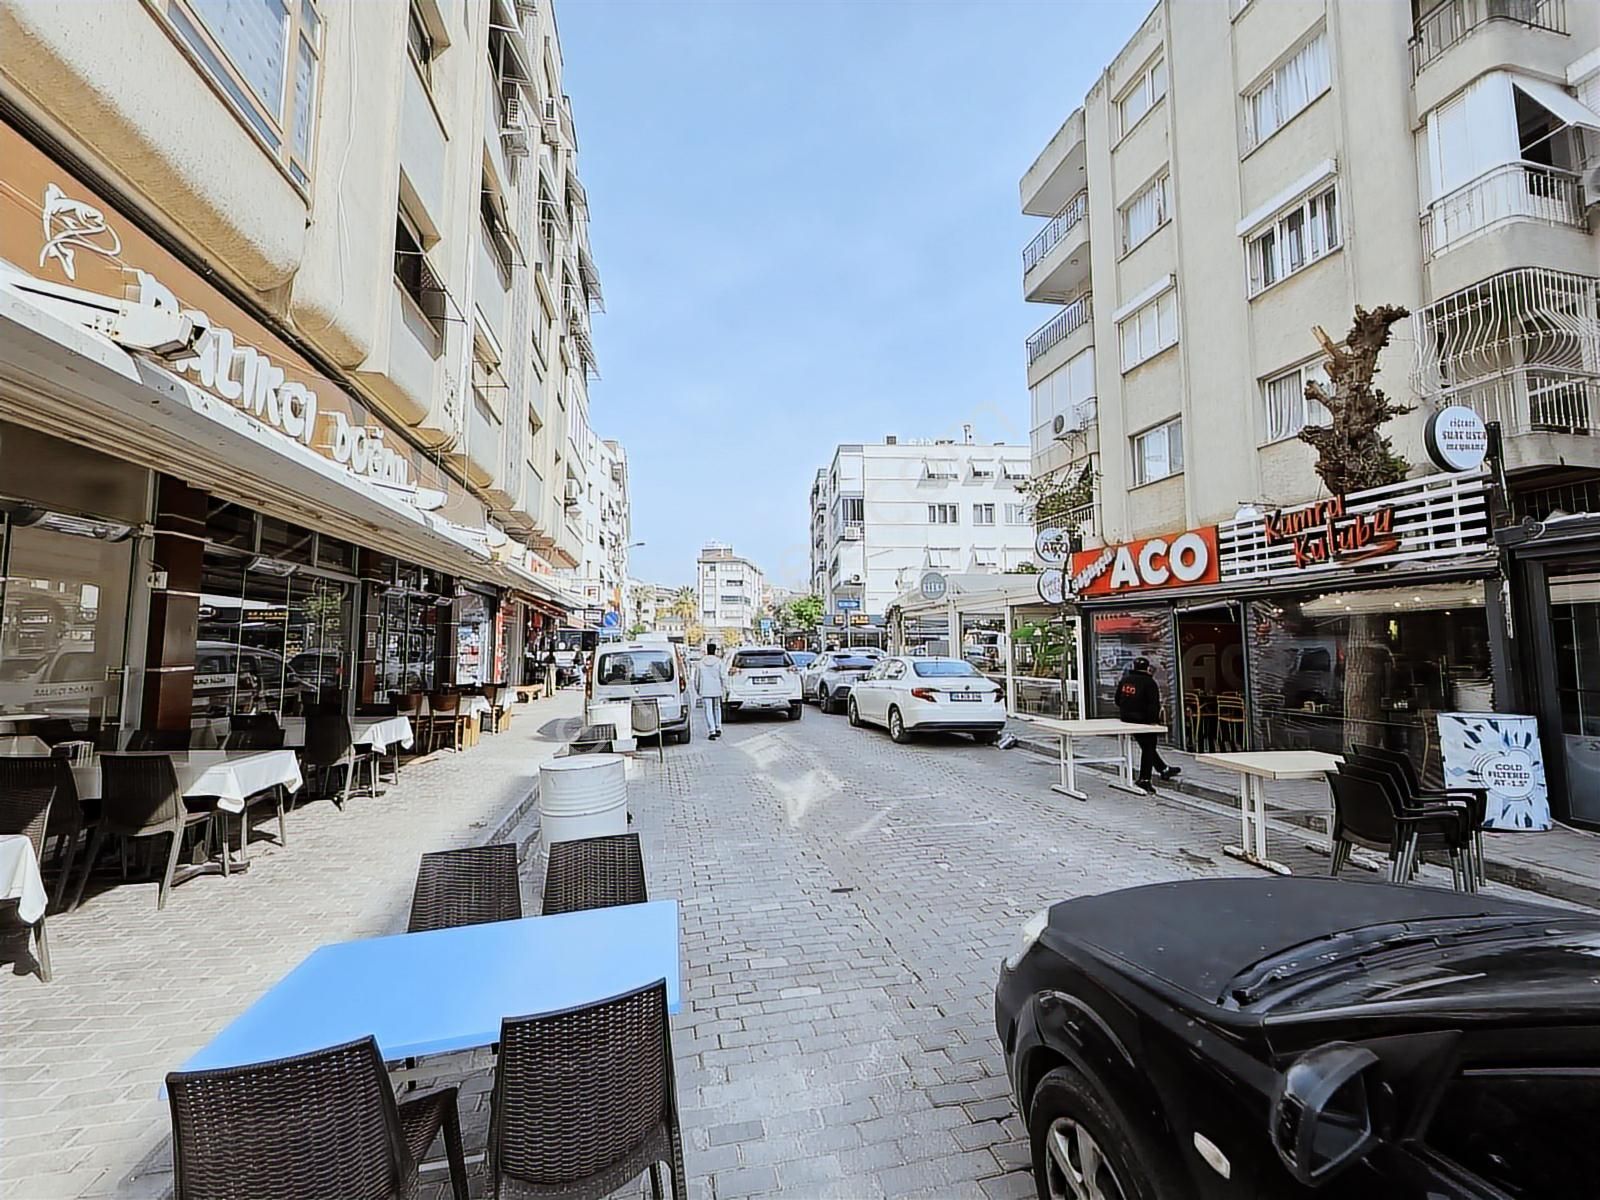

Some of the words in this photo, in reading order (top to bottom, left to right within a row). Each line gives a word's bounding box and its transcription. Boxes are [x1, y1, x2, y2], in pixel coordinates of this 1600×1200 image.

[1110, 533, 1208, 588] ACO
[1495, 763, 1522, 771] COLD
[1488, 771, 1530, 779] FILTERED
